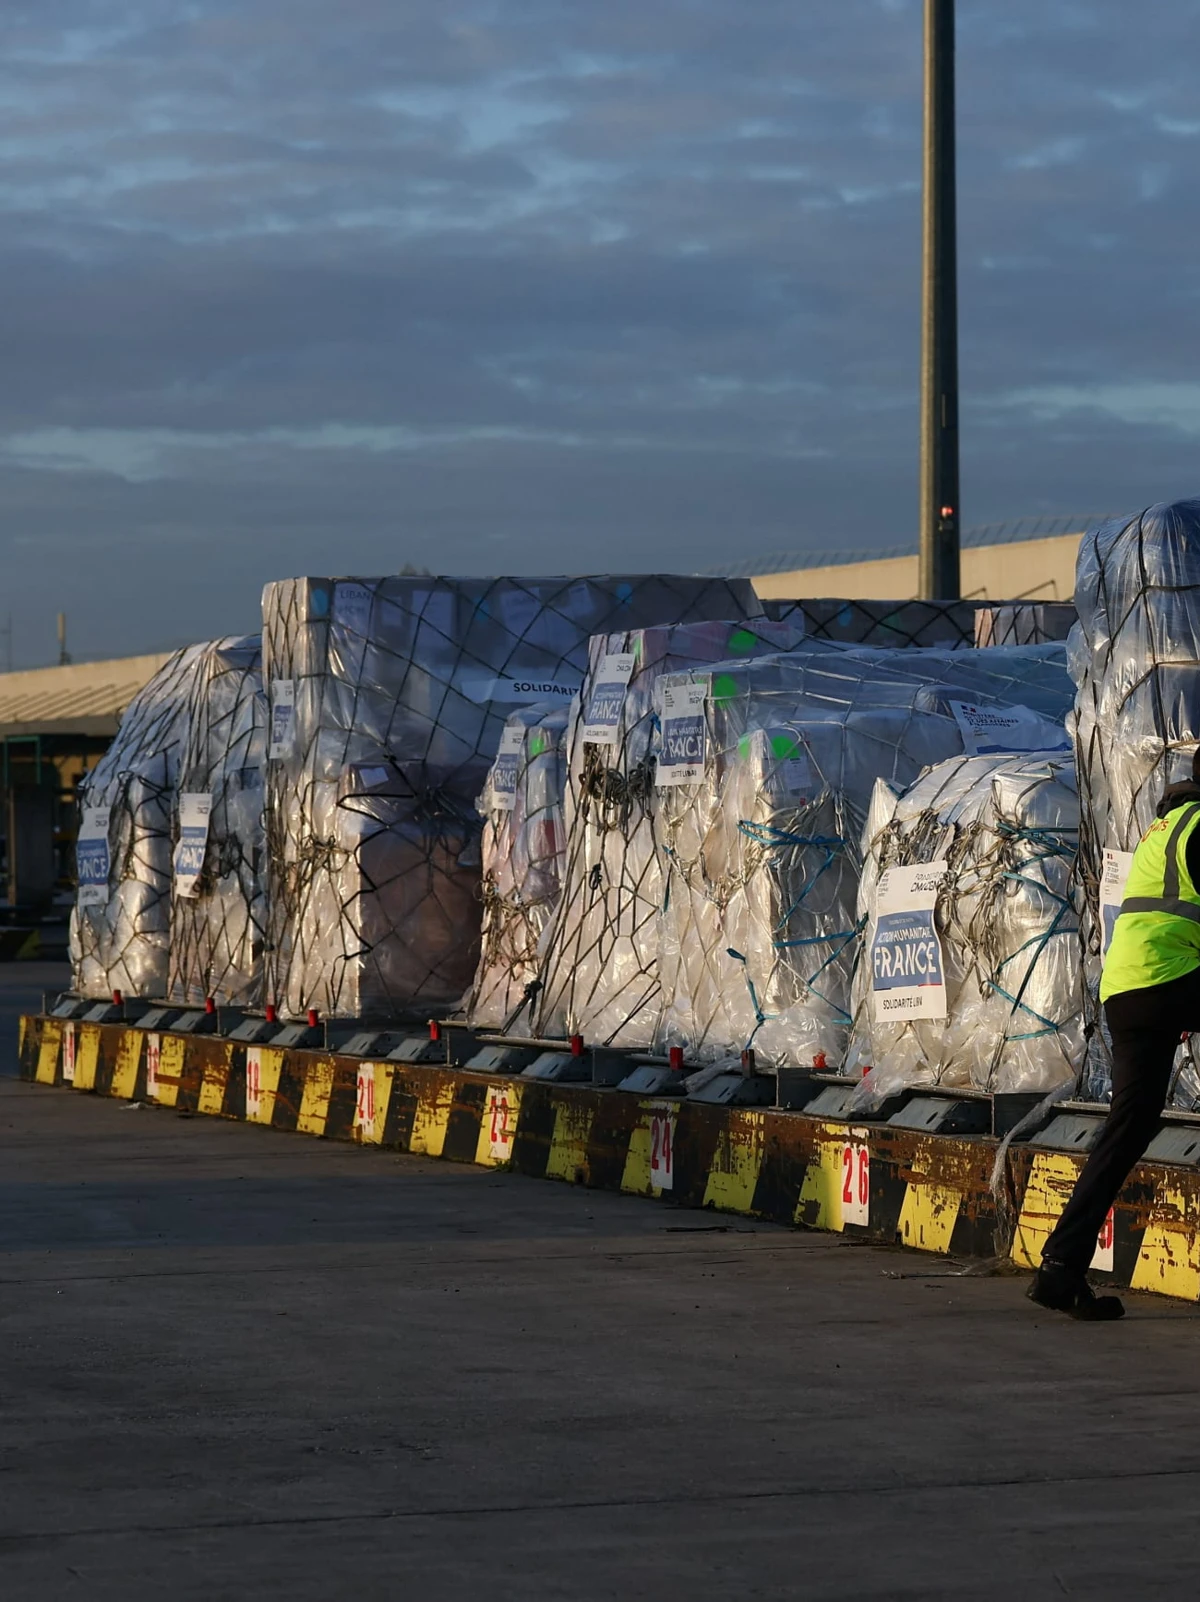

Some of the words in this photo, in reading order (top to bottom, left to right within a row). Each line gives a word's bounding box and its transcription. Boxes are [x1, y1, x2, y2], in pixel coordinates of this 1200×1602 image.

[513, 682, 579, 696] SOLIDARIT
[874, 941, 937, 979] FRANCE
[359, 1076, 374, 1120] 20
[651, 1118, 670, 1173] 24
[843, 1147, 868, 1205] 26
